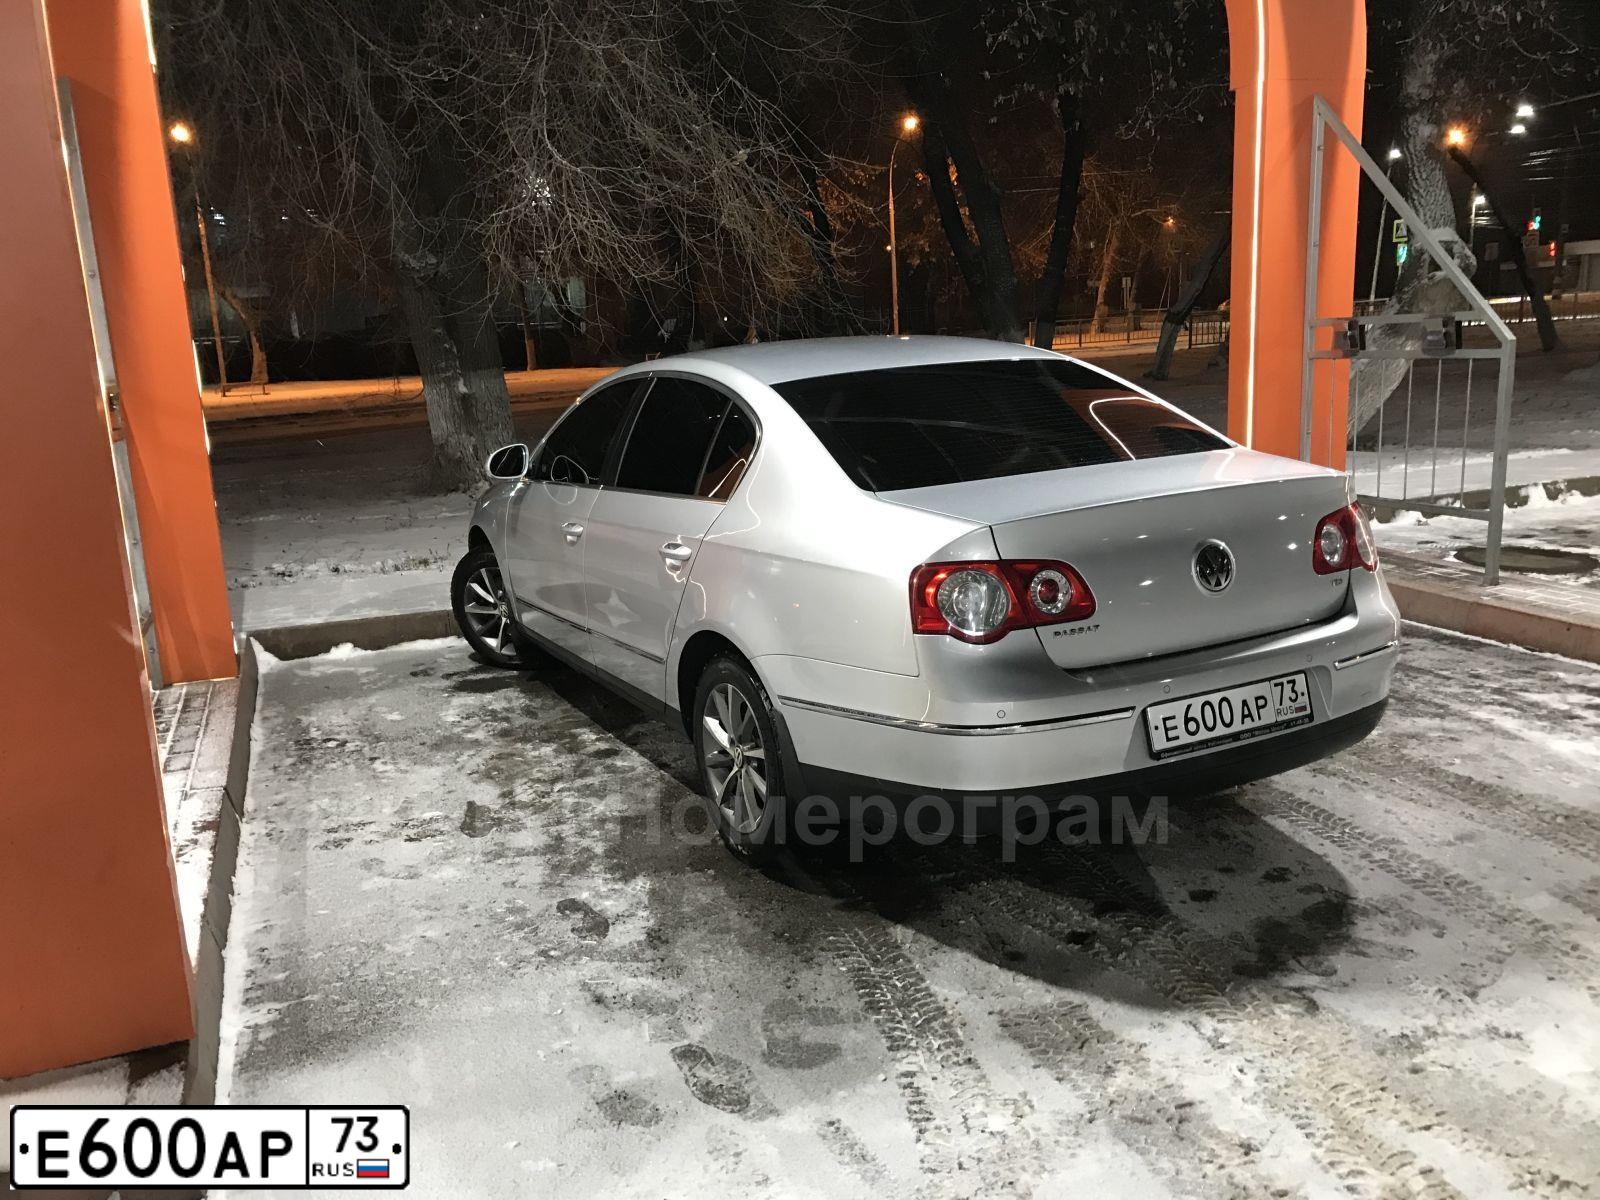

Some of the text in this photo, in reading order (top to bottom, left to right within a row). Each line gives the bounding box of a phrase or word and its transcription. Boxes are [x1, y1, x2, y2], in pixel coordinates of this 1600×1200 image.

[1053, 624, 1100, 638] PASSAT
[1273, 678, 1299, 706] 73
[1276, 705, 1295, 717] RUS
